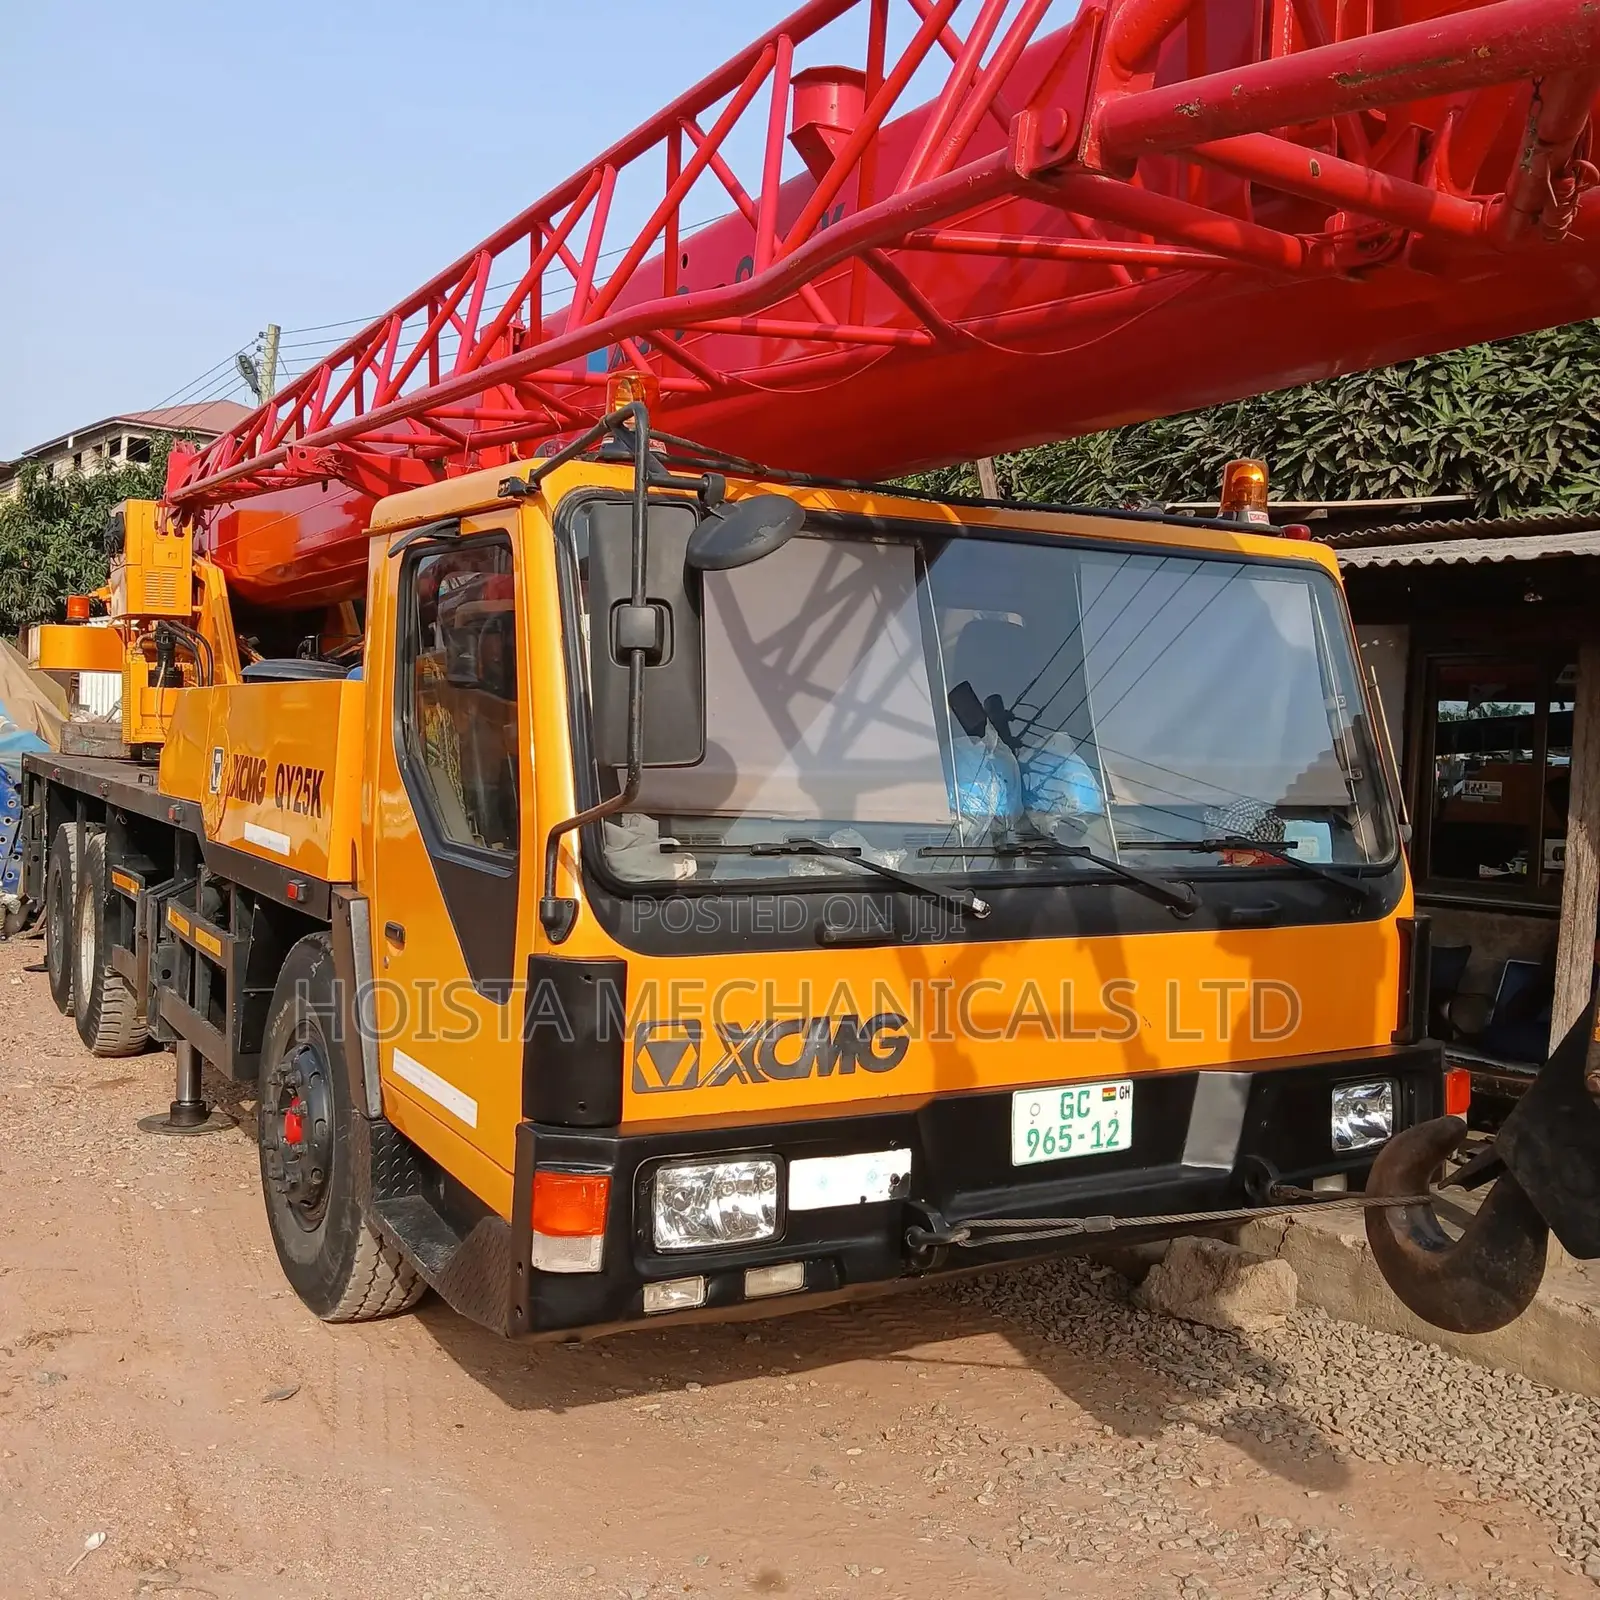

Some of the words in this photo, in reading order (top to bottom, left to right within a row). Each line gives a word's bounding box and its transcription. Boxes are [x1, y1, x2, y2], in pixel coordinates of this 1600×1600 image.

[227, 754, 267, 806] XCMG
[275, 763, 324, 819] QY25K
[698, 1012, 910, 1088] XCMG
[1060, 1090, 1091, 1120] GC
[1119, 1085, 1131, 1100] GH
[1027, 1118, 1120, 1158] 965-12
